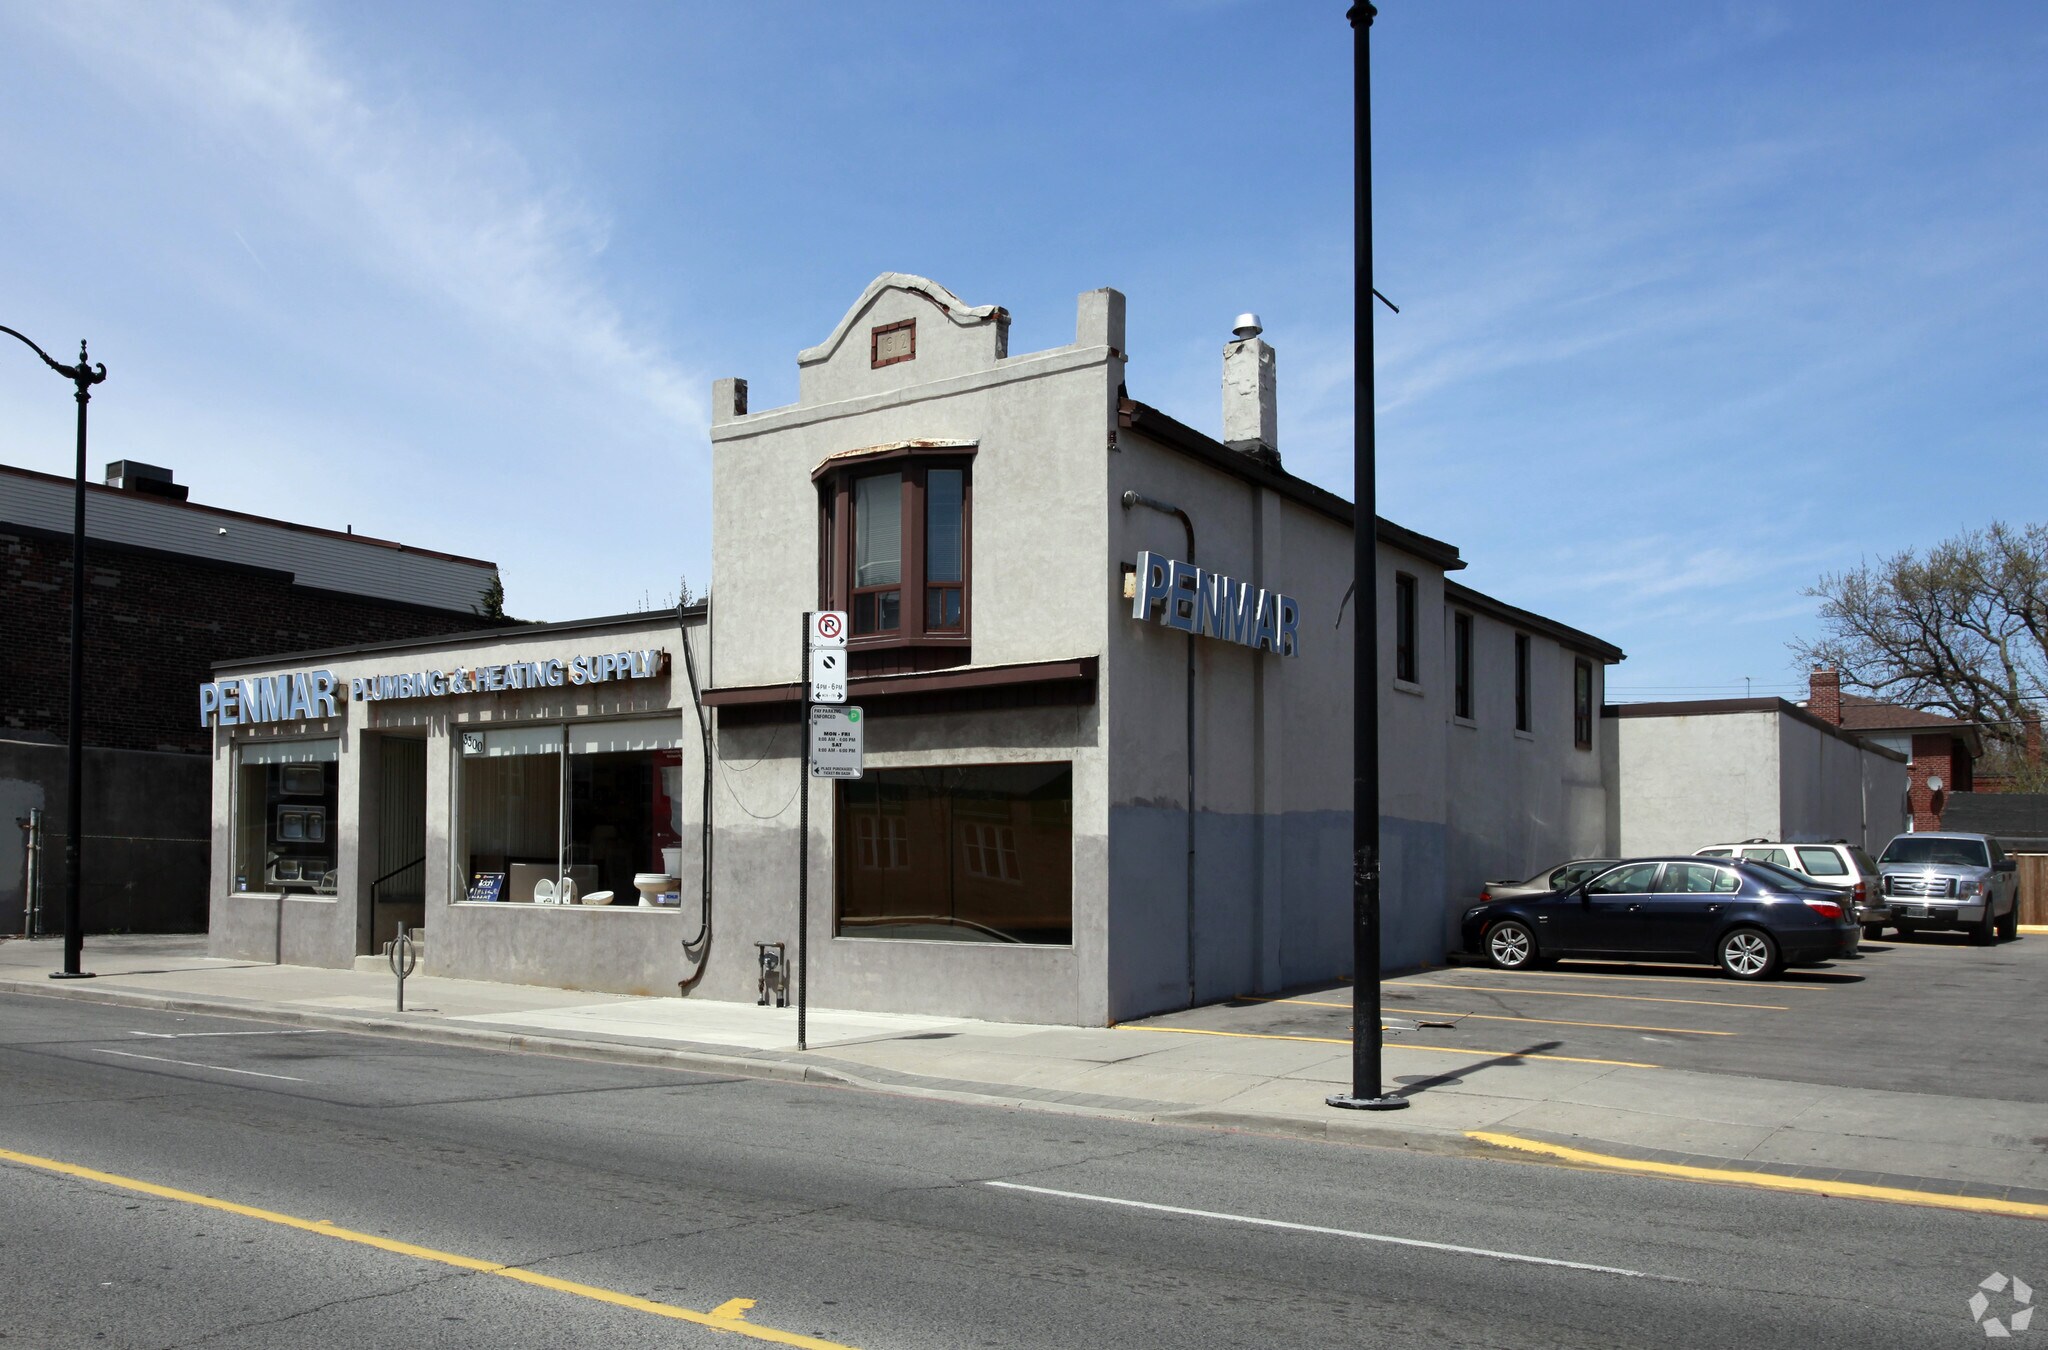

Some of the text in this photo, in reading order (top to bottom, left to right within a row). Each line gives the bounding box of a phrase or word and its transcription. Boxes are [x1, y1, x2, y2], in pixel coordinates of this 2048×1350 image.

[881, 333, 908, 354] 1912
[1132, 550, 1301, 658] PENMAR
[199, 668, 342, 728] PENMAR
[352, 648, 662, 702] PLUMBING & HEATING SUPPLY
[463, 733, 483, 752] 3300
